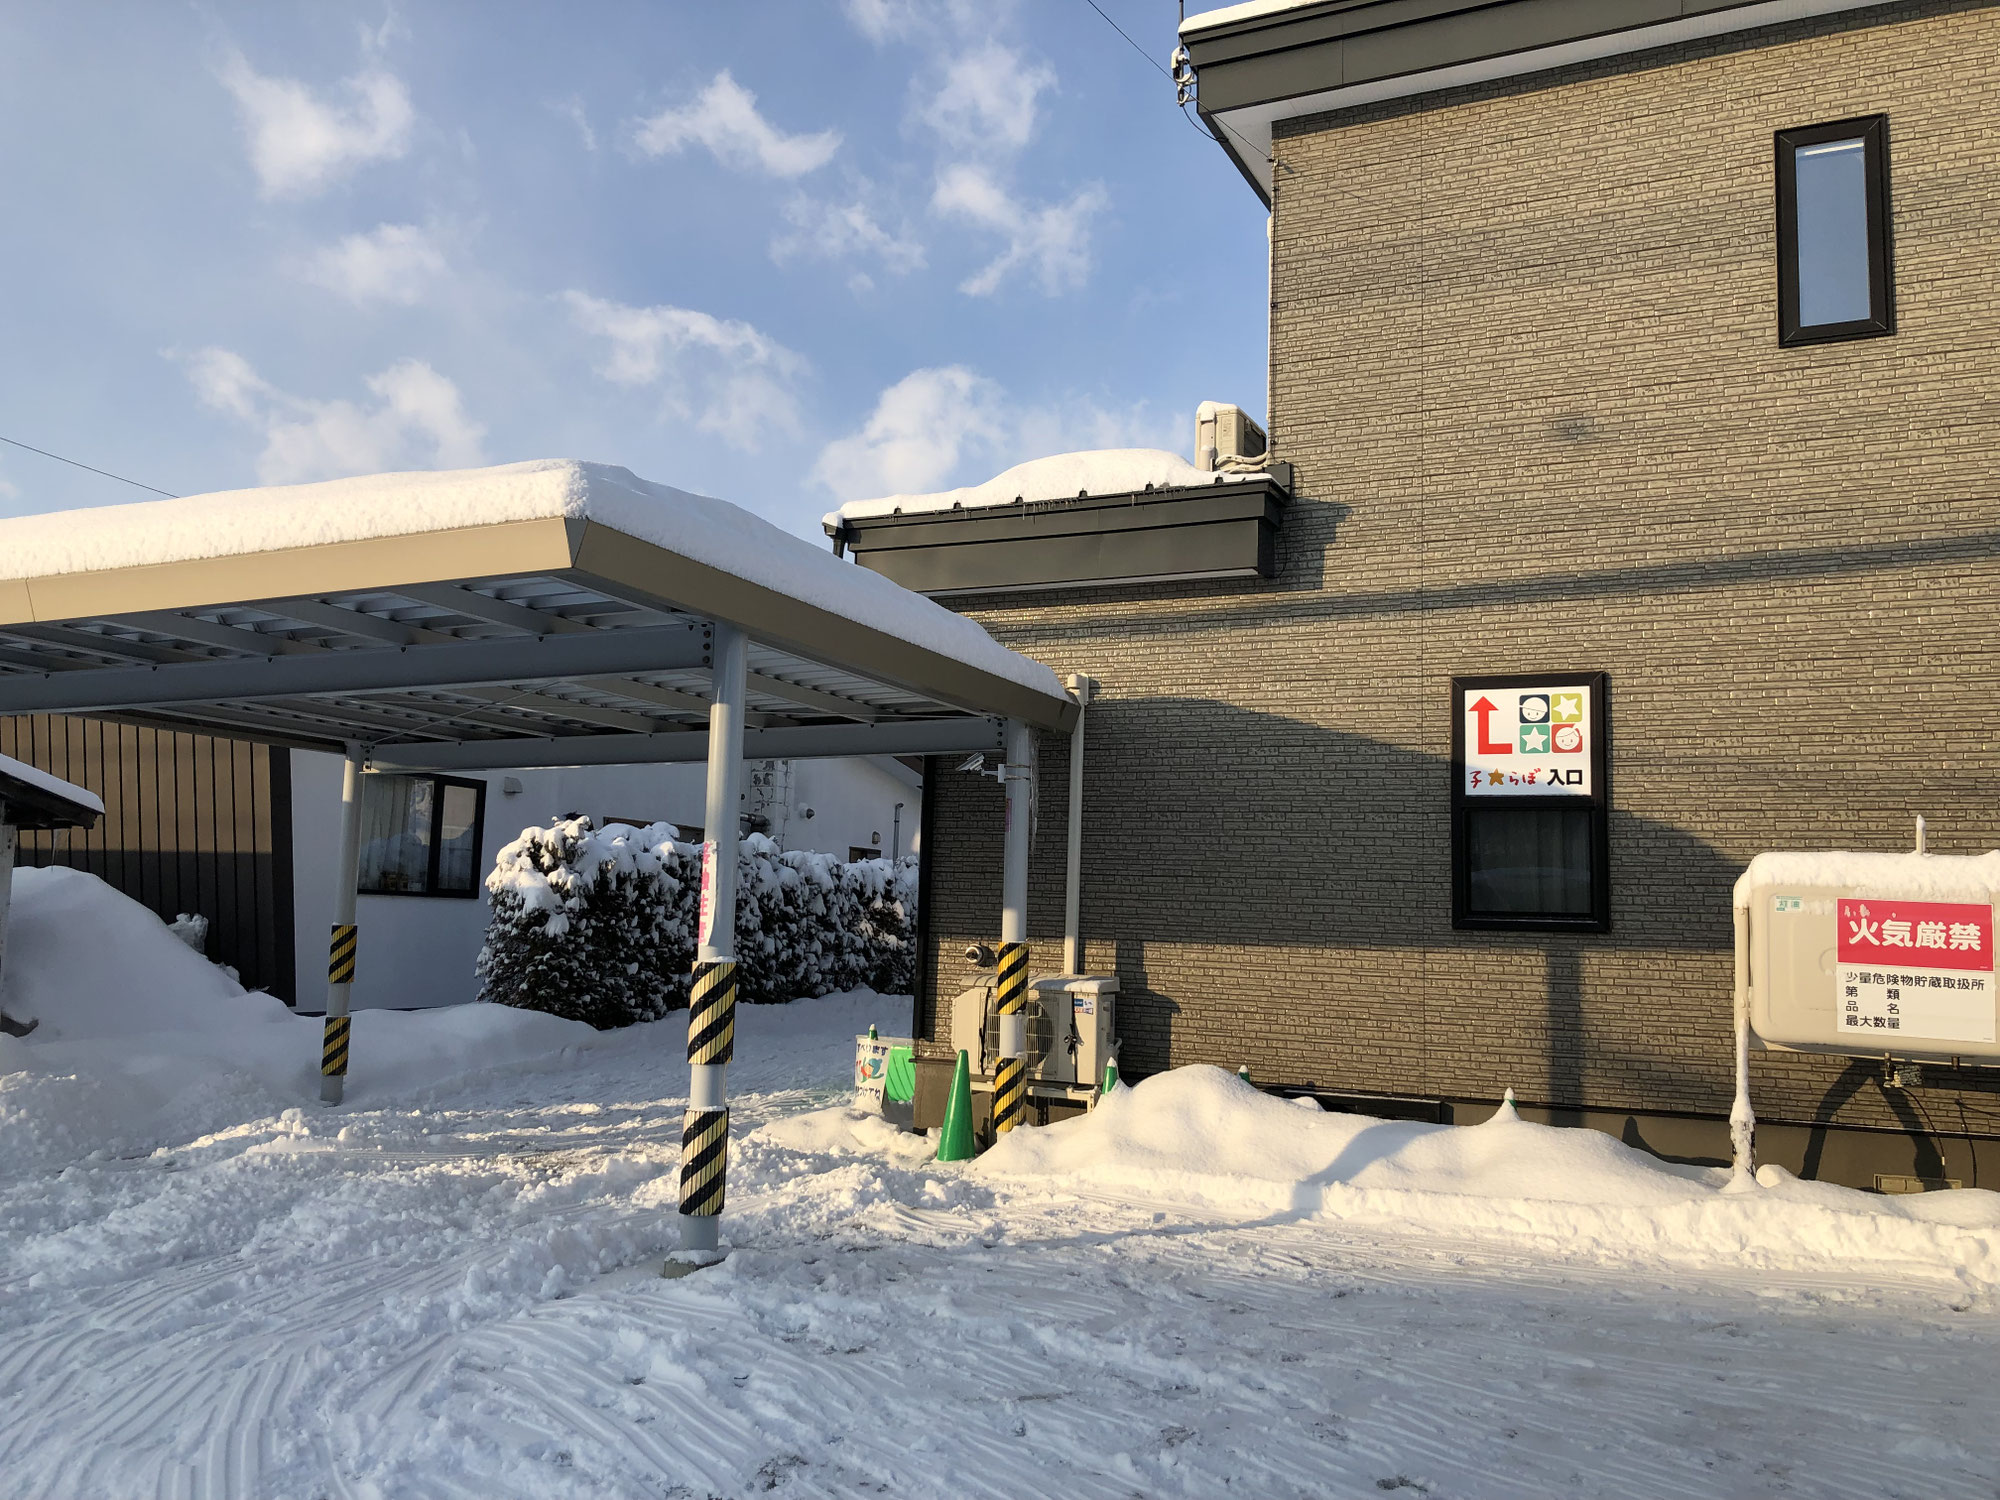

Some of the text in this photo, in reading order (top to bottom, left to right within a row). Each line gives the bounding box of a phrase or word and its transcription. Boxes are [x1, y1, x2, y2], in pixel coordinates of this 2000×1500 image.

[1547, 769, 1583, 786] 入口
[1848, 918, 1981, 951] 火気厳禁
[1845, 971, 1985, 991] 少量危険物貯蔵取扱所
[1845, 986, 1900, 1000] 第 類
[1845, 1000, 1900, 1015] 品 名
[1845, 1014, 1900, 1030] 最大数量
